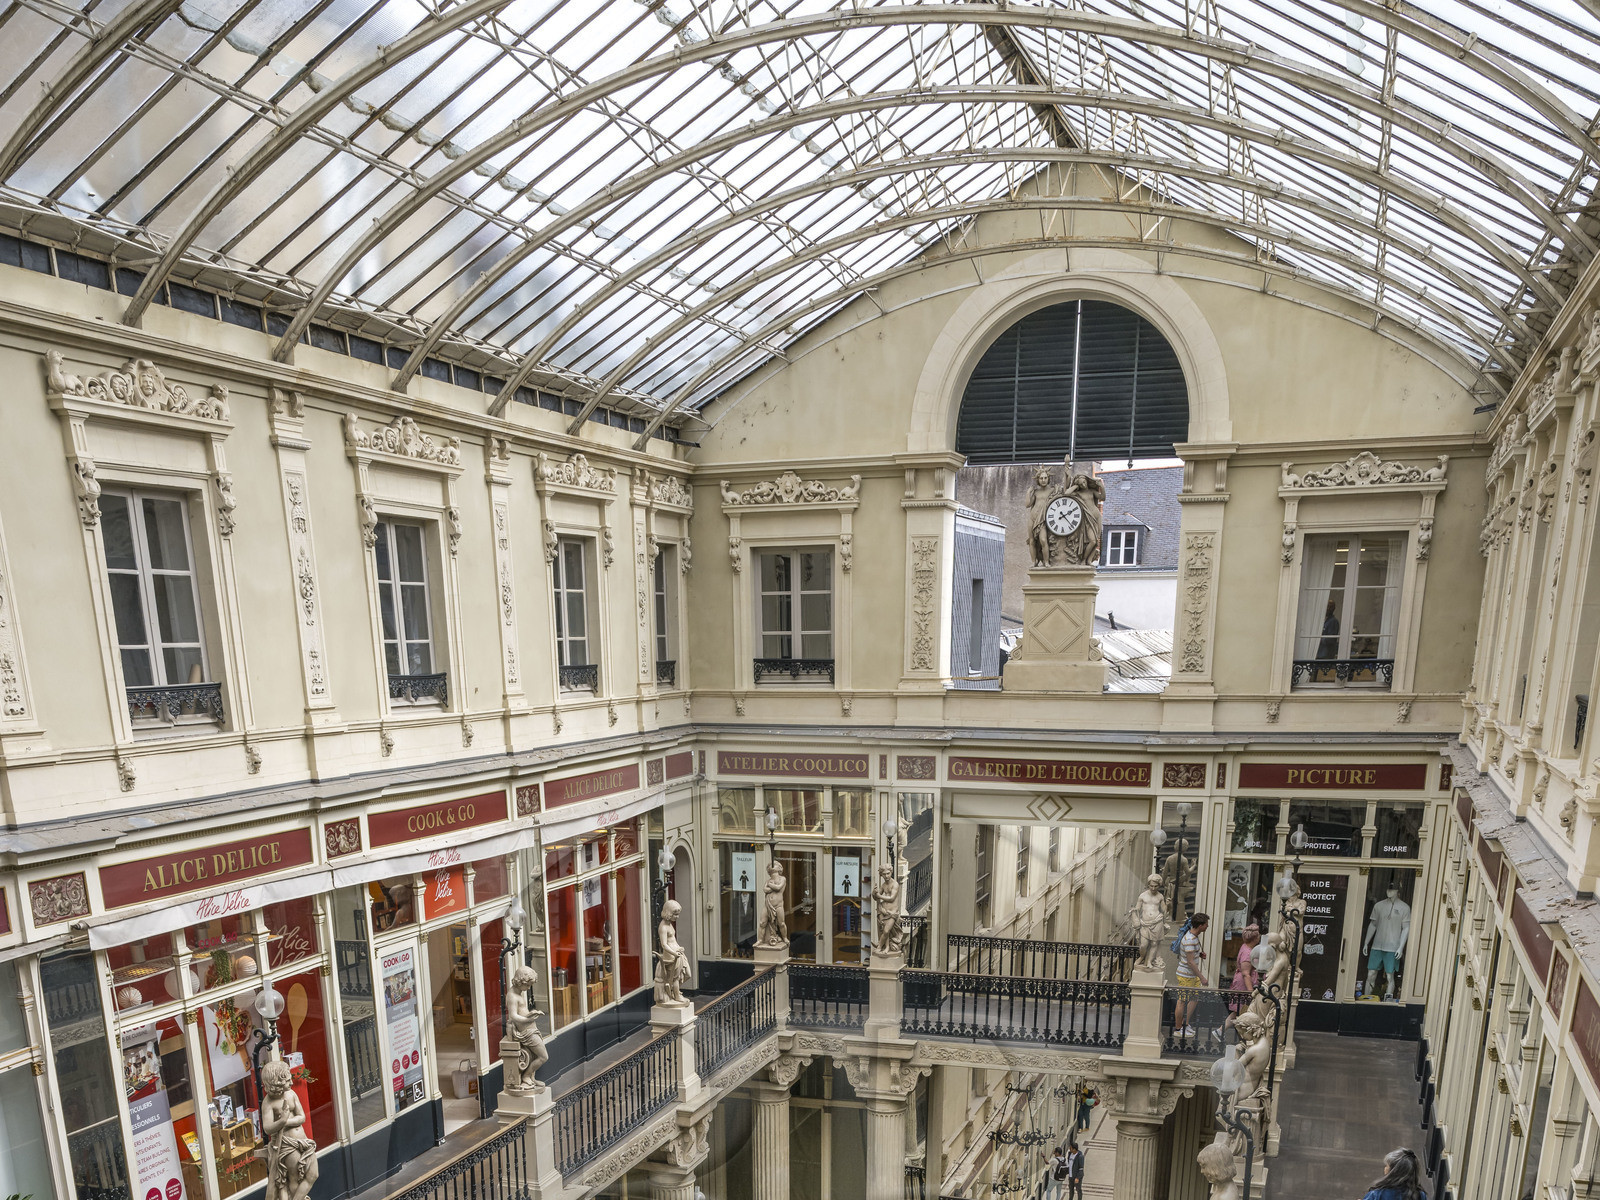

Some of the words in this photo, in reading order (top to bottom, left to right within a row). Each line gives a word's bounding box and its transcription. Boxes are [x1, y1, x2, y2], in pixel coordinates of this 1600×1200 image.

[721, 757, 790, 771] ATELIER
[793, 758, 867, 773] COQLICO
[951, 762, 1021, 778] GALERIE
[1026, 764, 1047, 779] DE
[1052, 764, 1148, 782] L'HORLOGE
[1286, 769, 1376, 784] PICTURE
[564, 777, 591, 800] ALICE
[593, 772, 624, 792] DELICE
[408, 809, 445, 833] COOK
[446, 808, 456, 824] &
[458, 803, 476, 822] GO
[143, 856, 208, 892] ALICE
[212, 842, 282, 877] DELICE
[196, 896, 221, 920] Alice
[221, 889, 251, 915] Délice
[198, 930, 238, 950] COOK&GO
[277, 924, 310, 950] Alice
